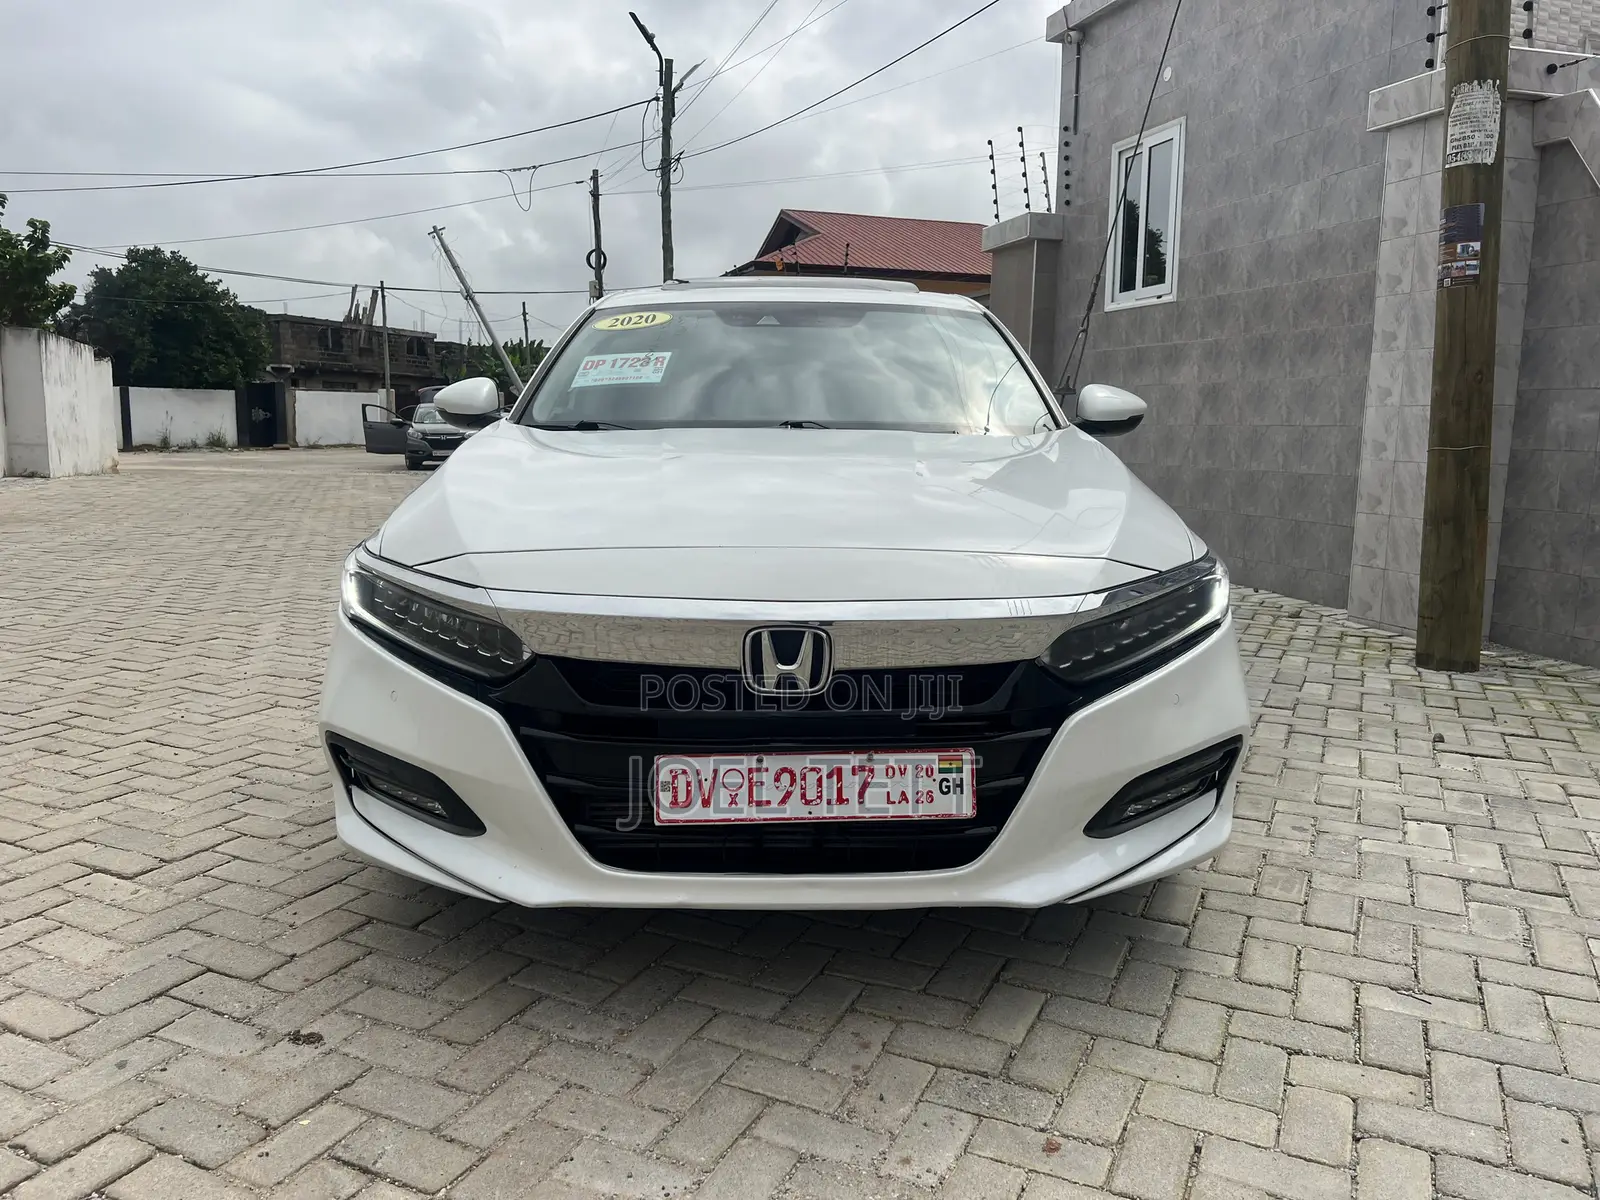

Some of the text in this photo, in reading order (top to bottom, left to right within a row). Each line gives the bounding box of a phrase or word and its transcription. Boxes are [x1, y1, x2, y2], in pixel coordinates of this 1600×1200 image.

[608, 313, 657, 328] 2020
[583, 359, 606, 371] DP
[654, 356, 667, 367] R
[915, 763, 935, 778] 20
[747, 765, 875, 808] E9017
[938, 777, 964, 796] GH
[886, 789, 935, 805] LA 26
